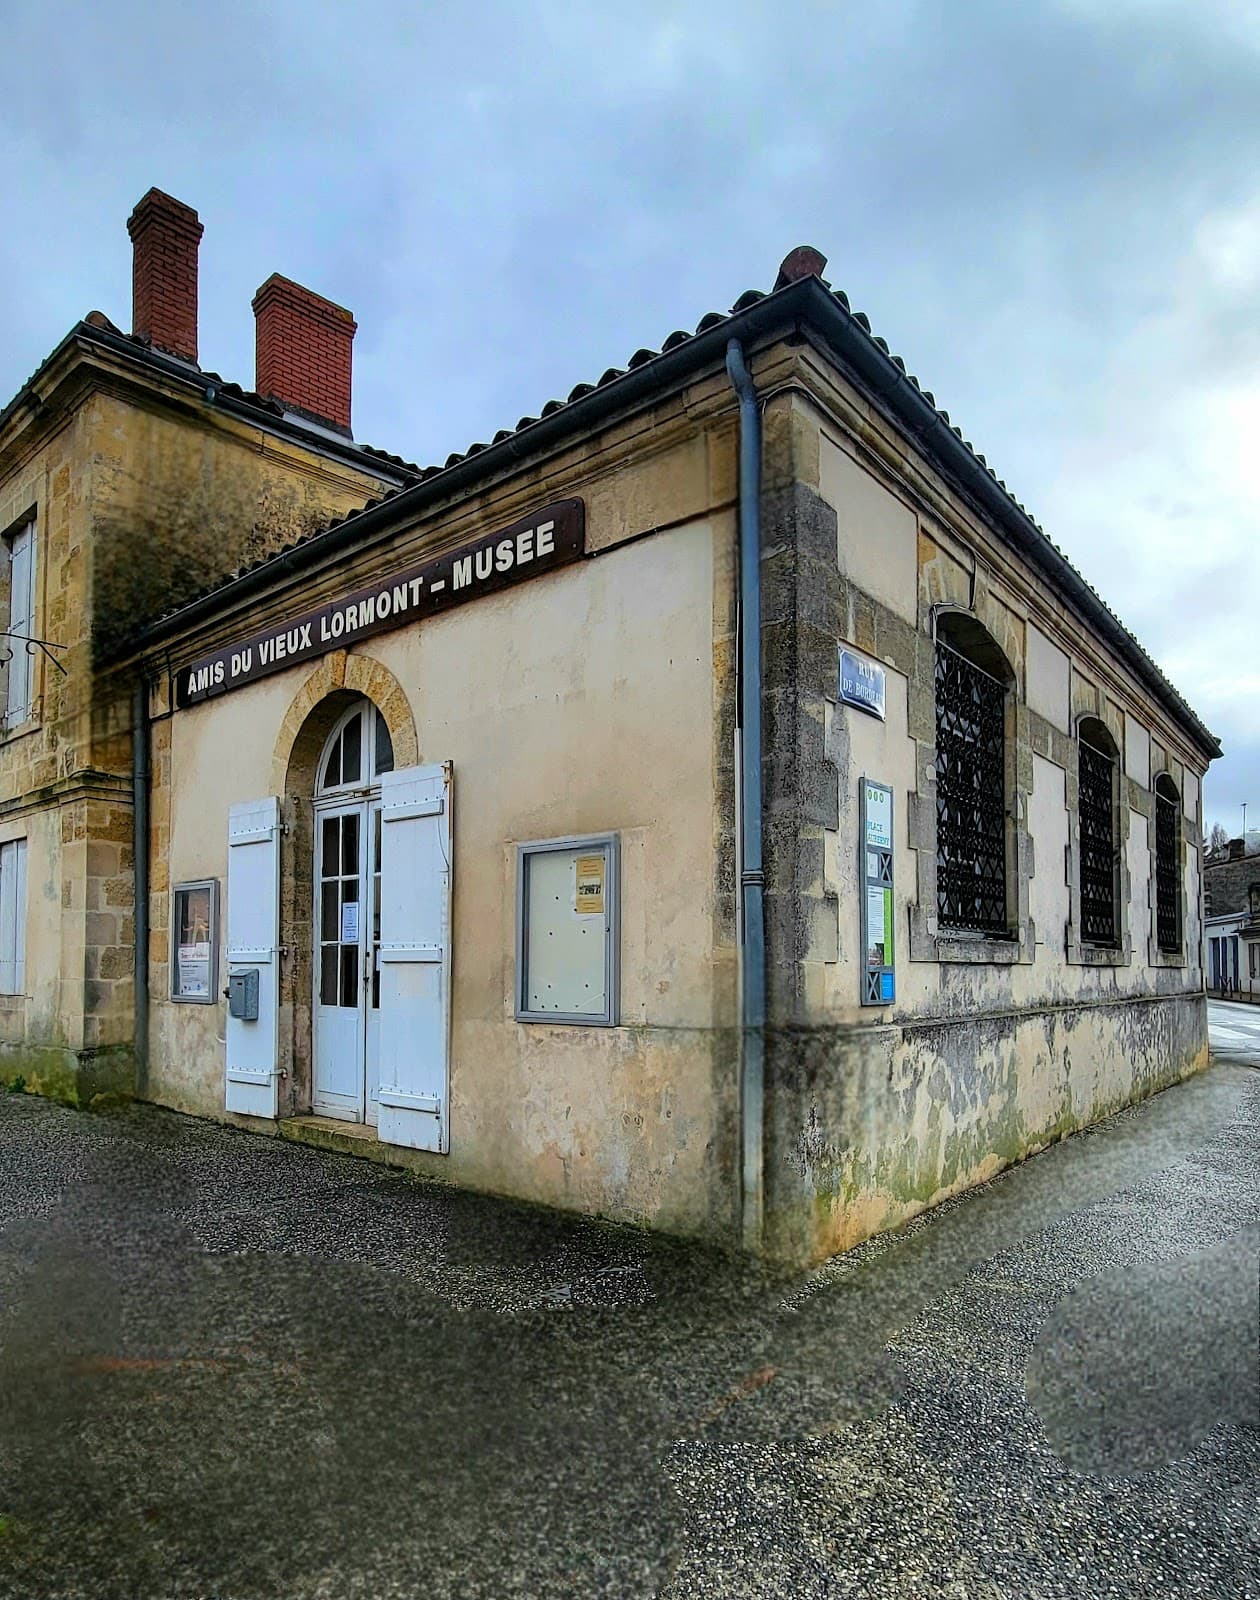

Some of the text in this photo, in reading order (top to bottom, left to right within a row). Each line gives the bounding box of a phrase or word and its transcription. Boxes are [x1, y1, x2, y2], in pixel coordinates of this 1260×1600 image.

[187, 661, 225, 695] AMIS
[231, 648, 252, 677] DU
[258, 623, 312, 665] VIEUX
[321, 577, 423, 642] LORMONT
[453, 520, 555, 591] MUSEE
[843, 678, 853, 694] DE
